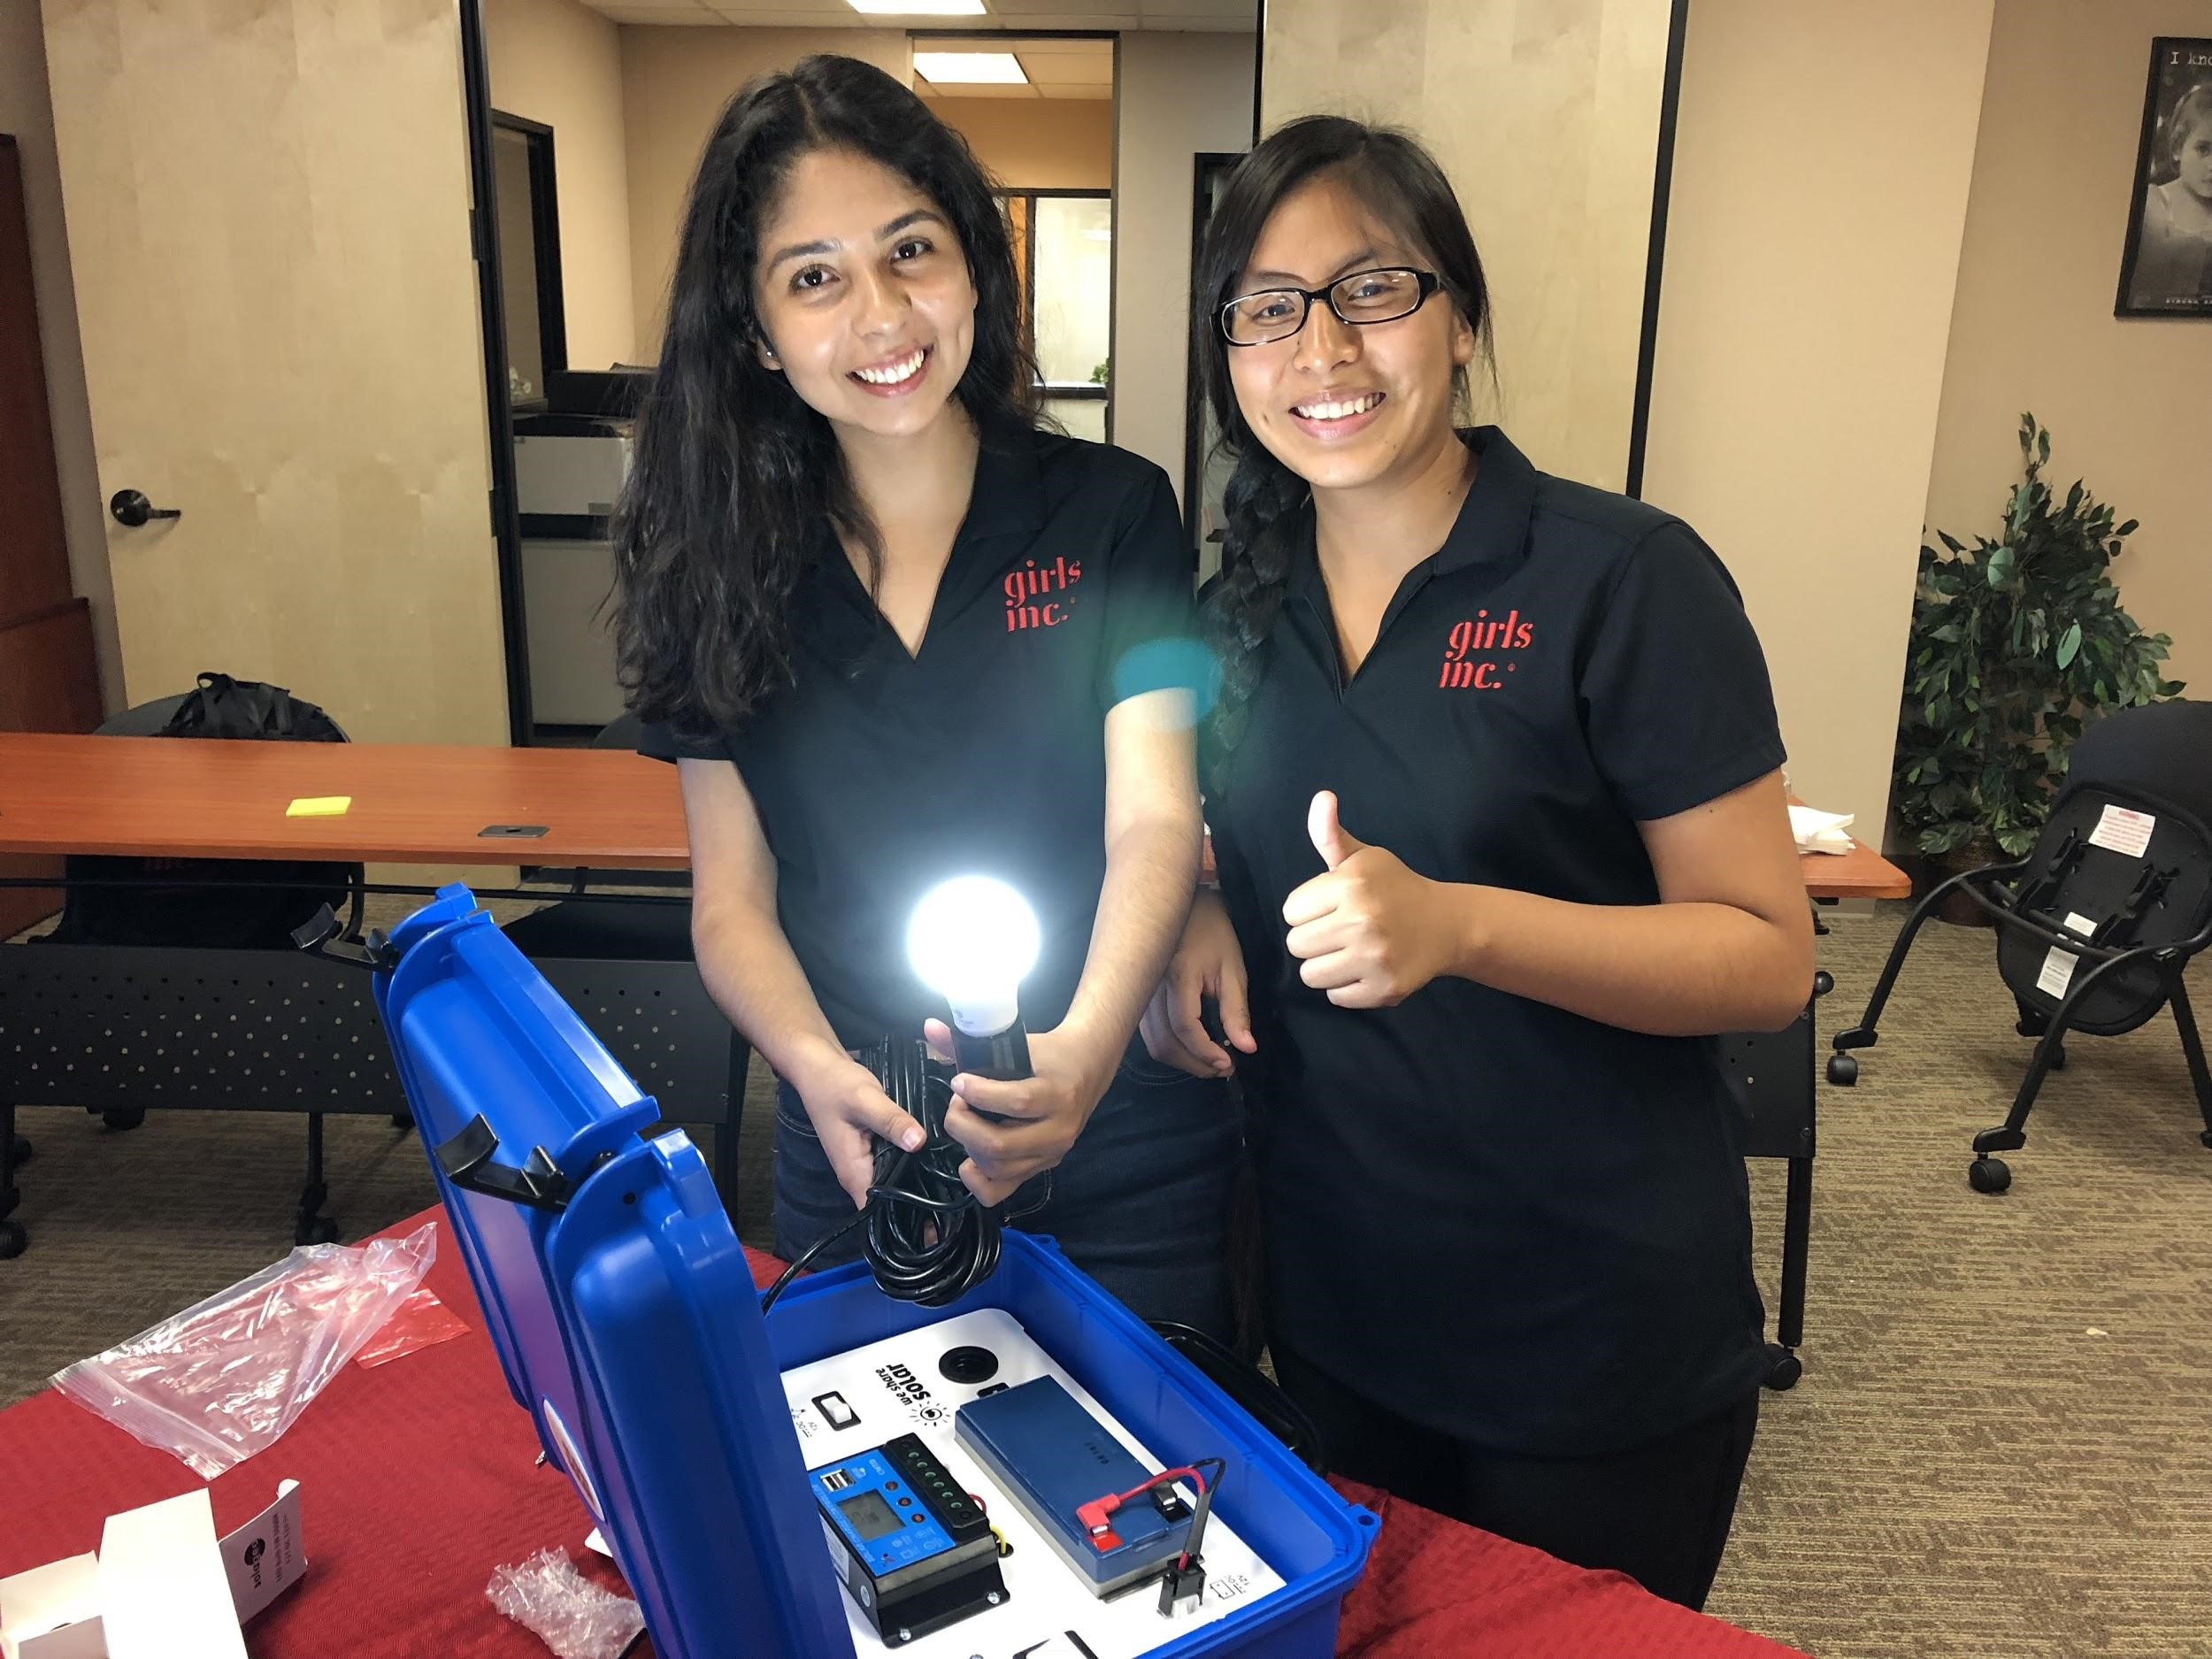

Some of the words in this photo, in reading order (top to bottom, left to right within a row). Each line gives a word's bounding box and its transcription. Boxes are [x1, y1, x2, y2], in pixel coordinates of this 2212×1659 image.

[2170, 51, 2179, 65] I
[1004, 557, 1081, 608] girls
[1448, 610, 1533, 661] girls
[1439, 651, 1502, 688] inc.
[875, 1368, 901, 1392] share
[886, 1363, 932, 1401] solar
[895, 1392, 913, 1406] we
